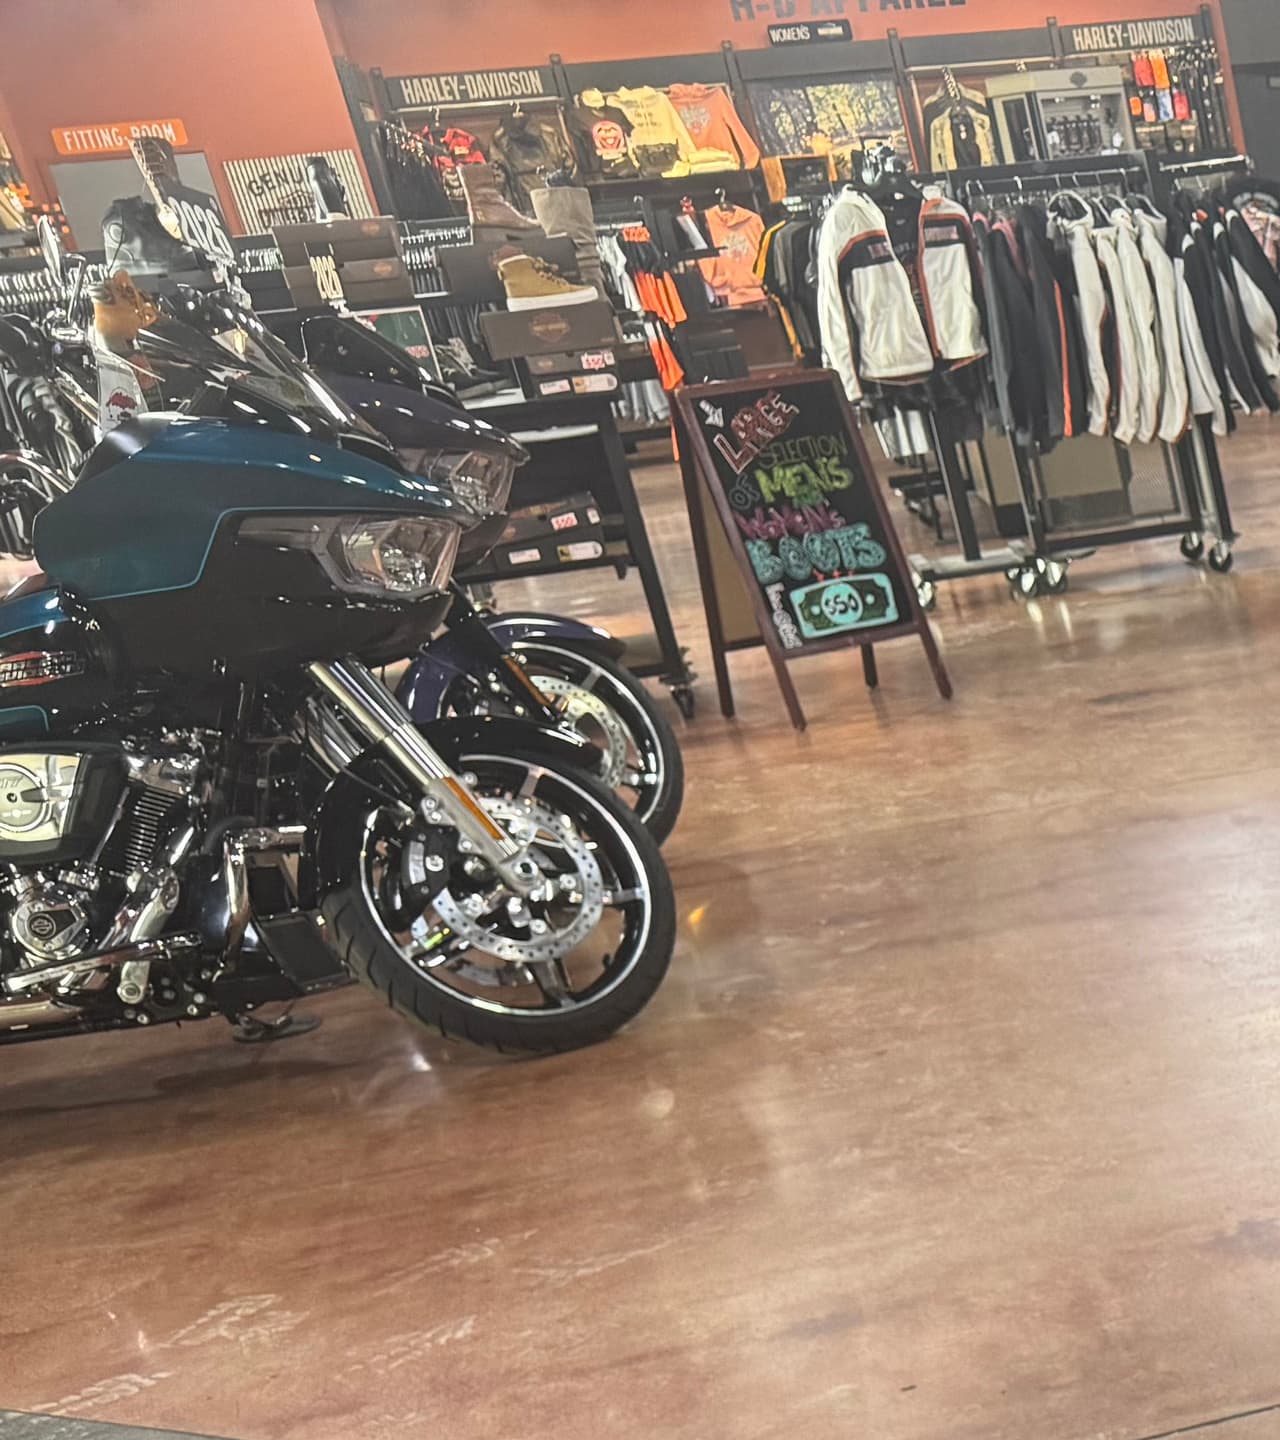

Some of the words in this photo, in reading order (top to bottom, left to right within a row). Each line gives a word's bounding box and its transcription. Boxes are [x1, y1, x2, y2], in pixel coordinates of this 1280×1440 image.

[1072, 17, 1194, 51] HARLEY-DAVIDSON
[400, 70, 543, 104] HARLEY-DAVIDSON
[63, 127, 125, 151] FITTING
[167, 196, 234, 259] 2026
